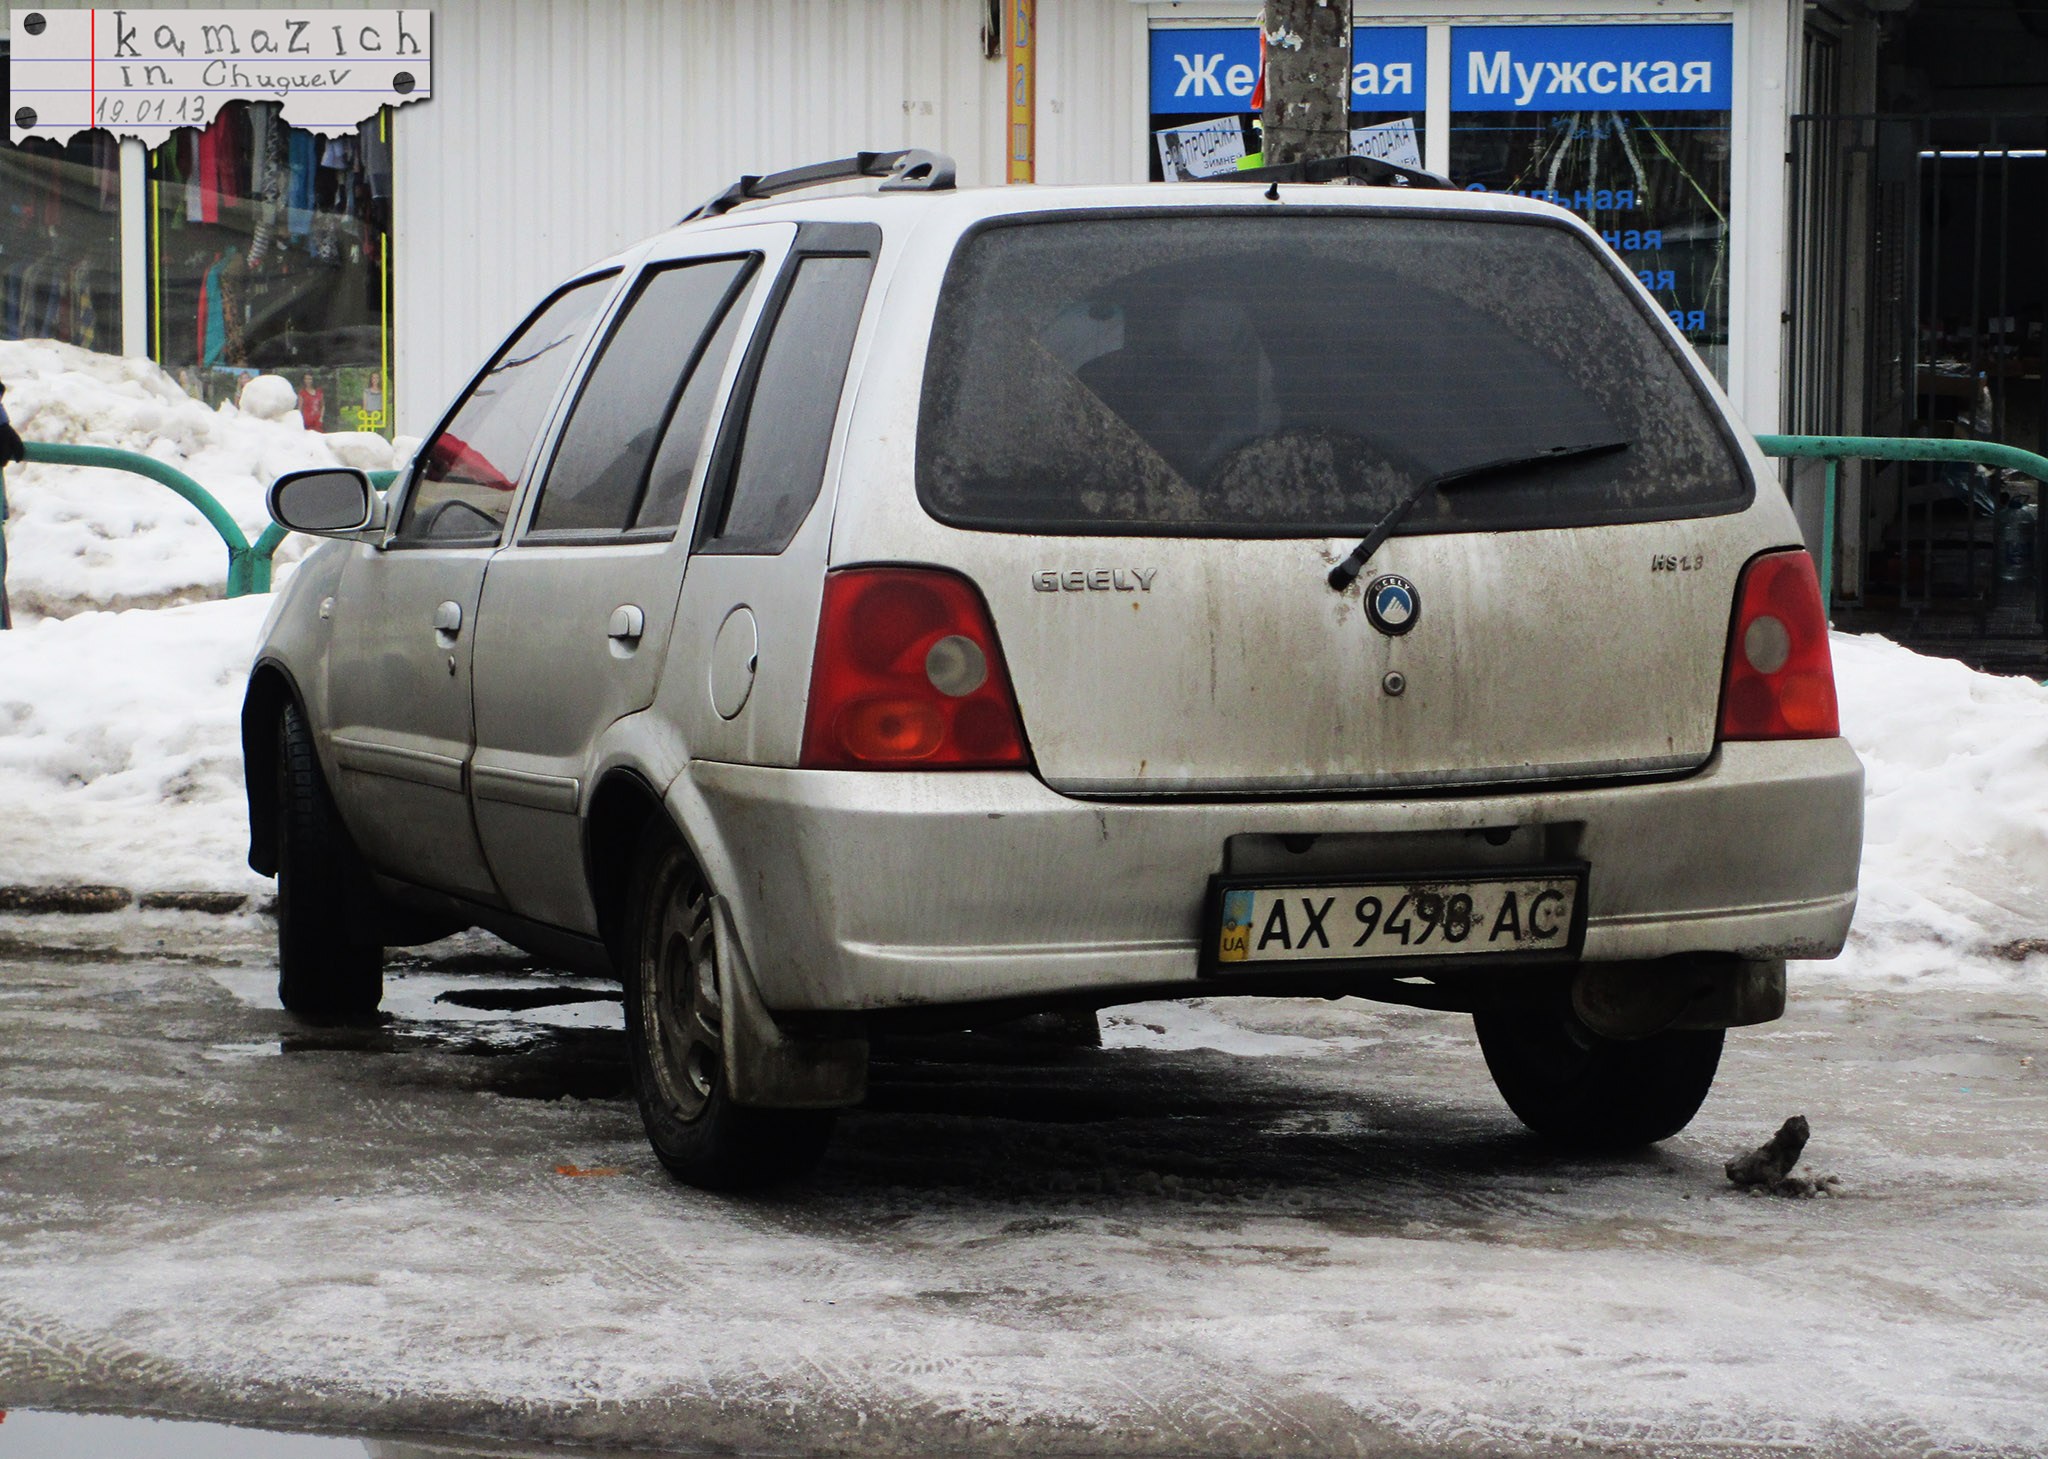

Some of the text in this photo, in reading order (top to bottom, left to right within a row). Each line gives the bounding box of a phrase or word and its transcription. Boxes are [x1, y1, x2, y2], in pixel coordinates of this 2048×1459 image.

[1174, 53, 1412, 97] Жеая
[1468, 50, 1712, 105] Мужская
[1032, 567, 1157, 592] GEELY
[1257, 889, 1565, 951] AX 9498 AC
[1223, 936, 1245, 953] UA
